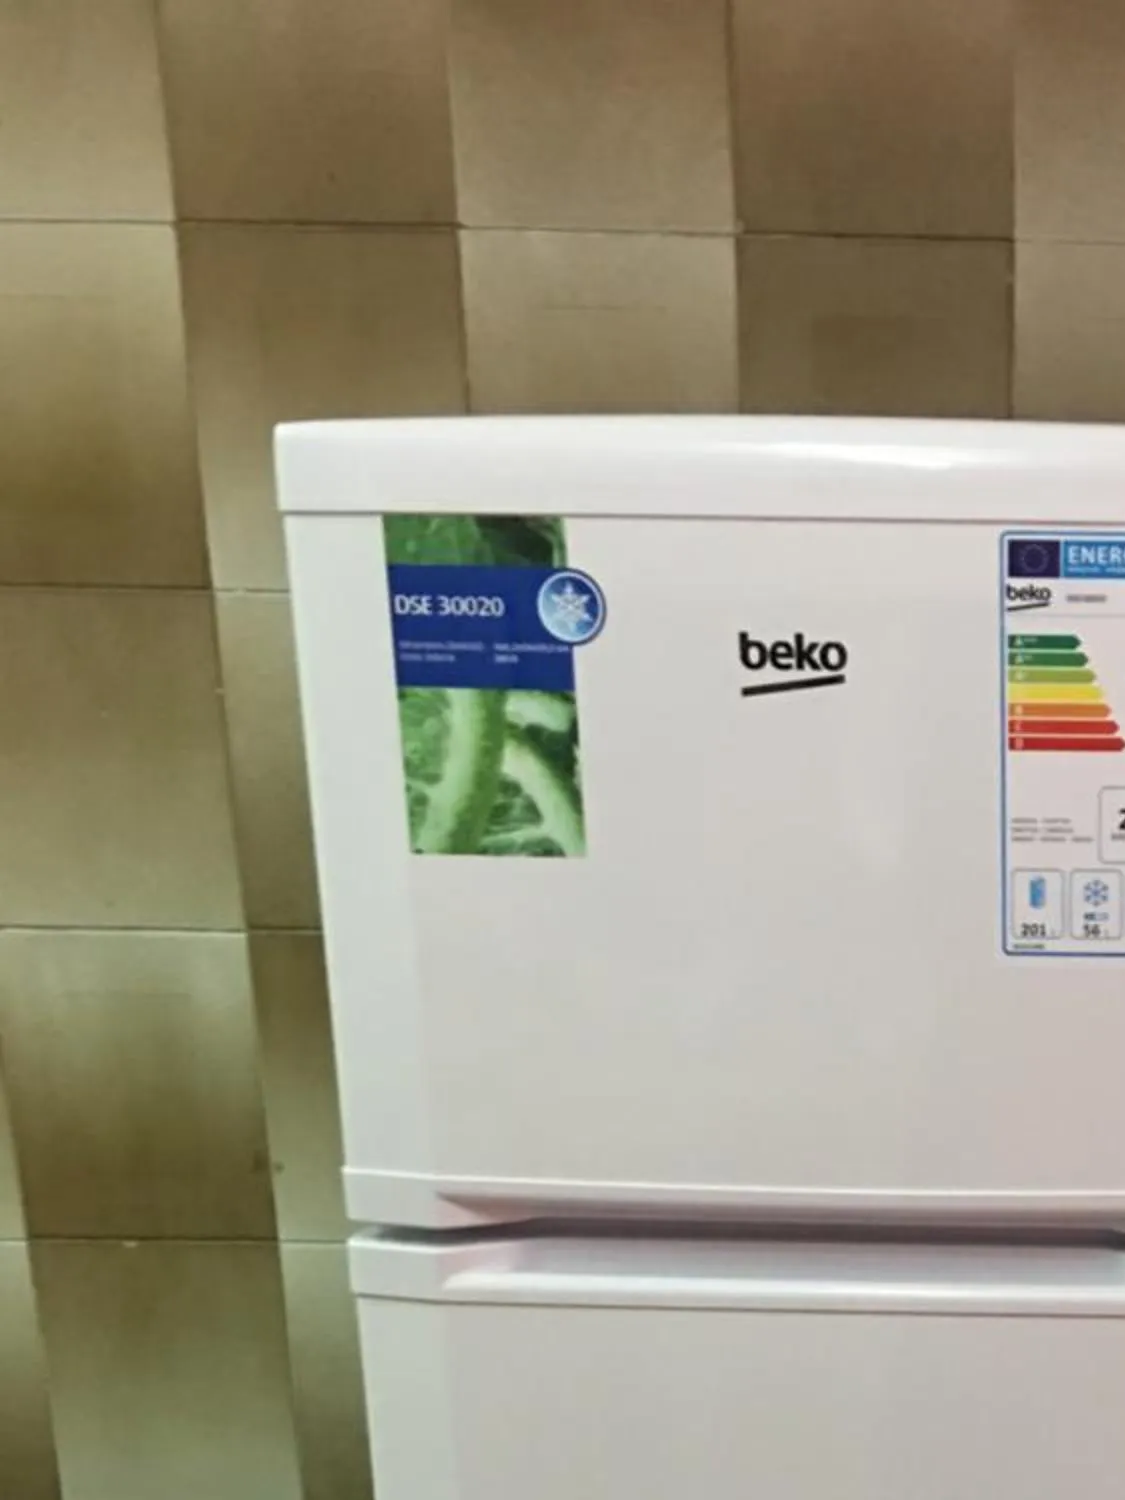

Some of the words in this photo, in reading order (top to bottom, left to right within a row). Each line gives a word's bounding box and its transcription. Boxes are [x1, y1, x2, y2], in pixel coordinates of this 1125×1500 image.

[1006, 584, 1052, 601] beko
[394, 594, 433, 617] DSE
[436, 595, 506, 618] 30020
[738, 630, 848, 672] beko
